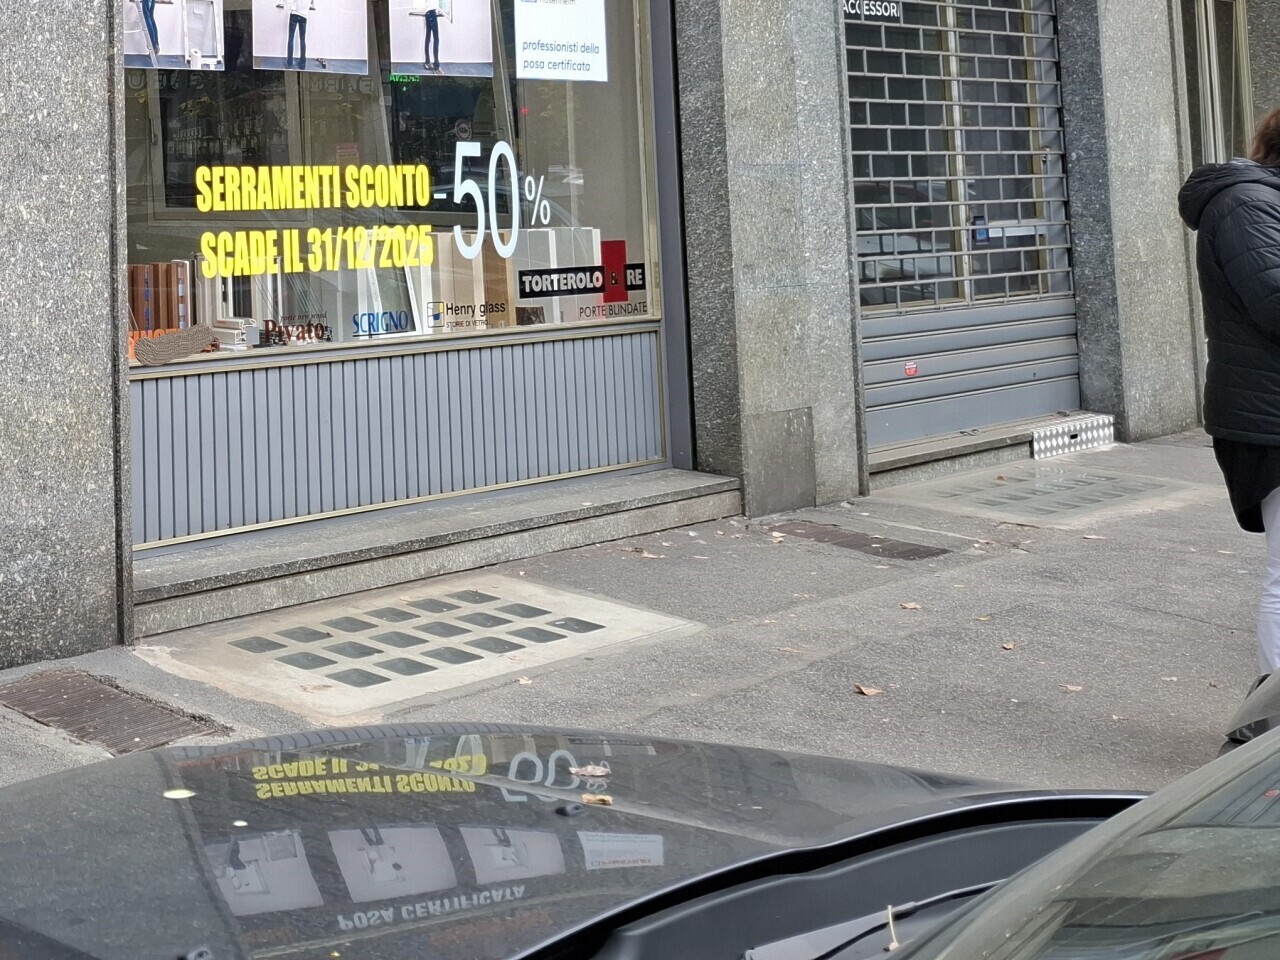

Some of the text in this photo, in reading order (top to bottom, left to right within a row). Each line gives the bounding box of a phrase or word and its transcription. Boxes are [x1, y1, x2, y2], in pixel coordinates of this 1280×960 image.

[523, 39, 600, 54] professionisti della
[523, 58, 591, 72] posa certificata
[196, 164, 430, 212] SERRAMENTI SCONTO
[201, 224, 433, 279] SCADE IL 31/12/2025
[522, 269, 642, 293] TORTEROLO & RE
[446, 300, 506, 319] Henry glass
[580, 300, 647, 318] PORTE BLINDATE
[263, 319, 324, 343] Pivato
[352, 310, 409, 334] SCRIGNO
